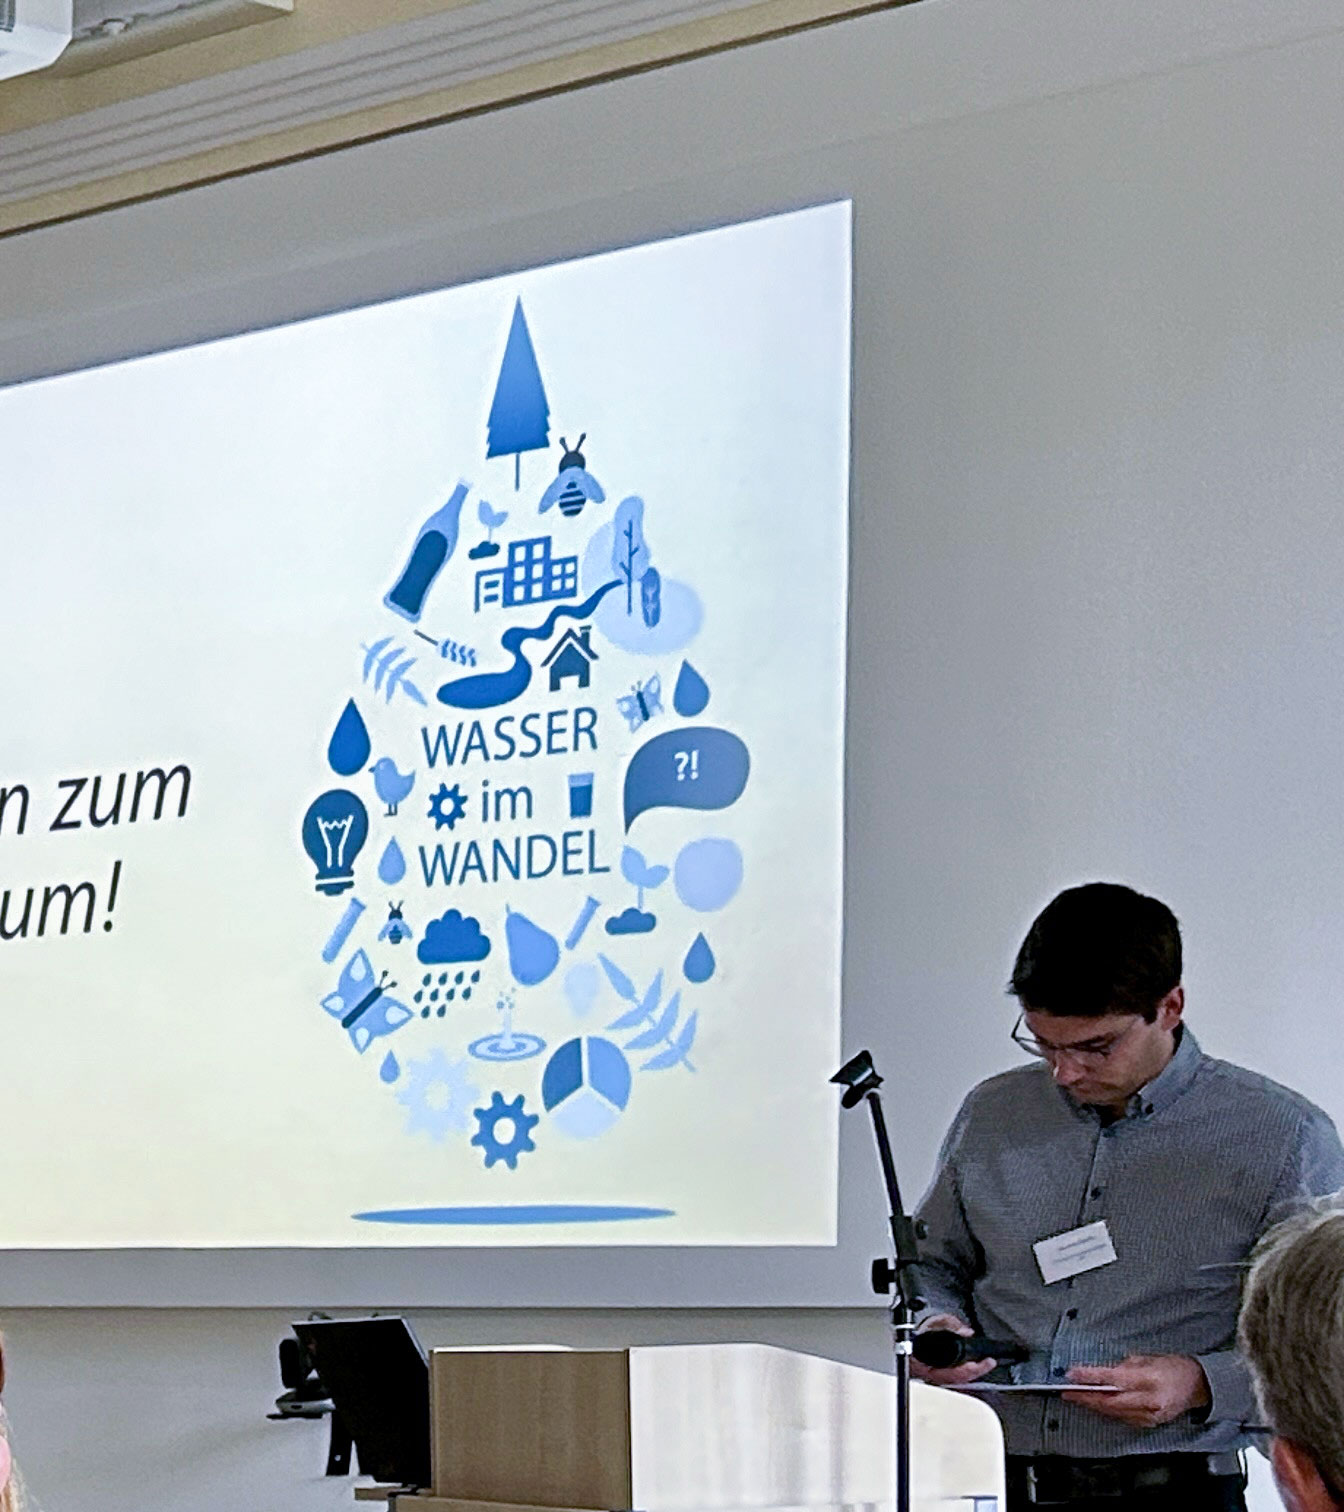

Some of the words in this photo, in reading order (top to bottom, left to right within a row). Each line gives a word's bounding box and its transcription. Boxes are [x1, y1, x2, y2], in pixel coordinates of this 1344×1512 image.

[421, 706, 598, 769] WASSER
[674, 749, 700, 781] ?!
[49, 764, 191, 831] zum
[481, 779, 533, 823] im
[418, 828, 611, 888] WANDEL
